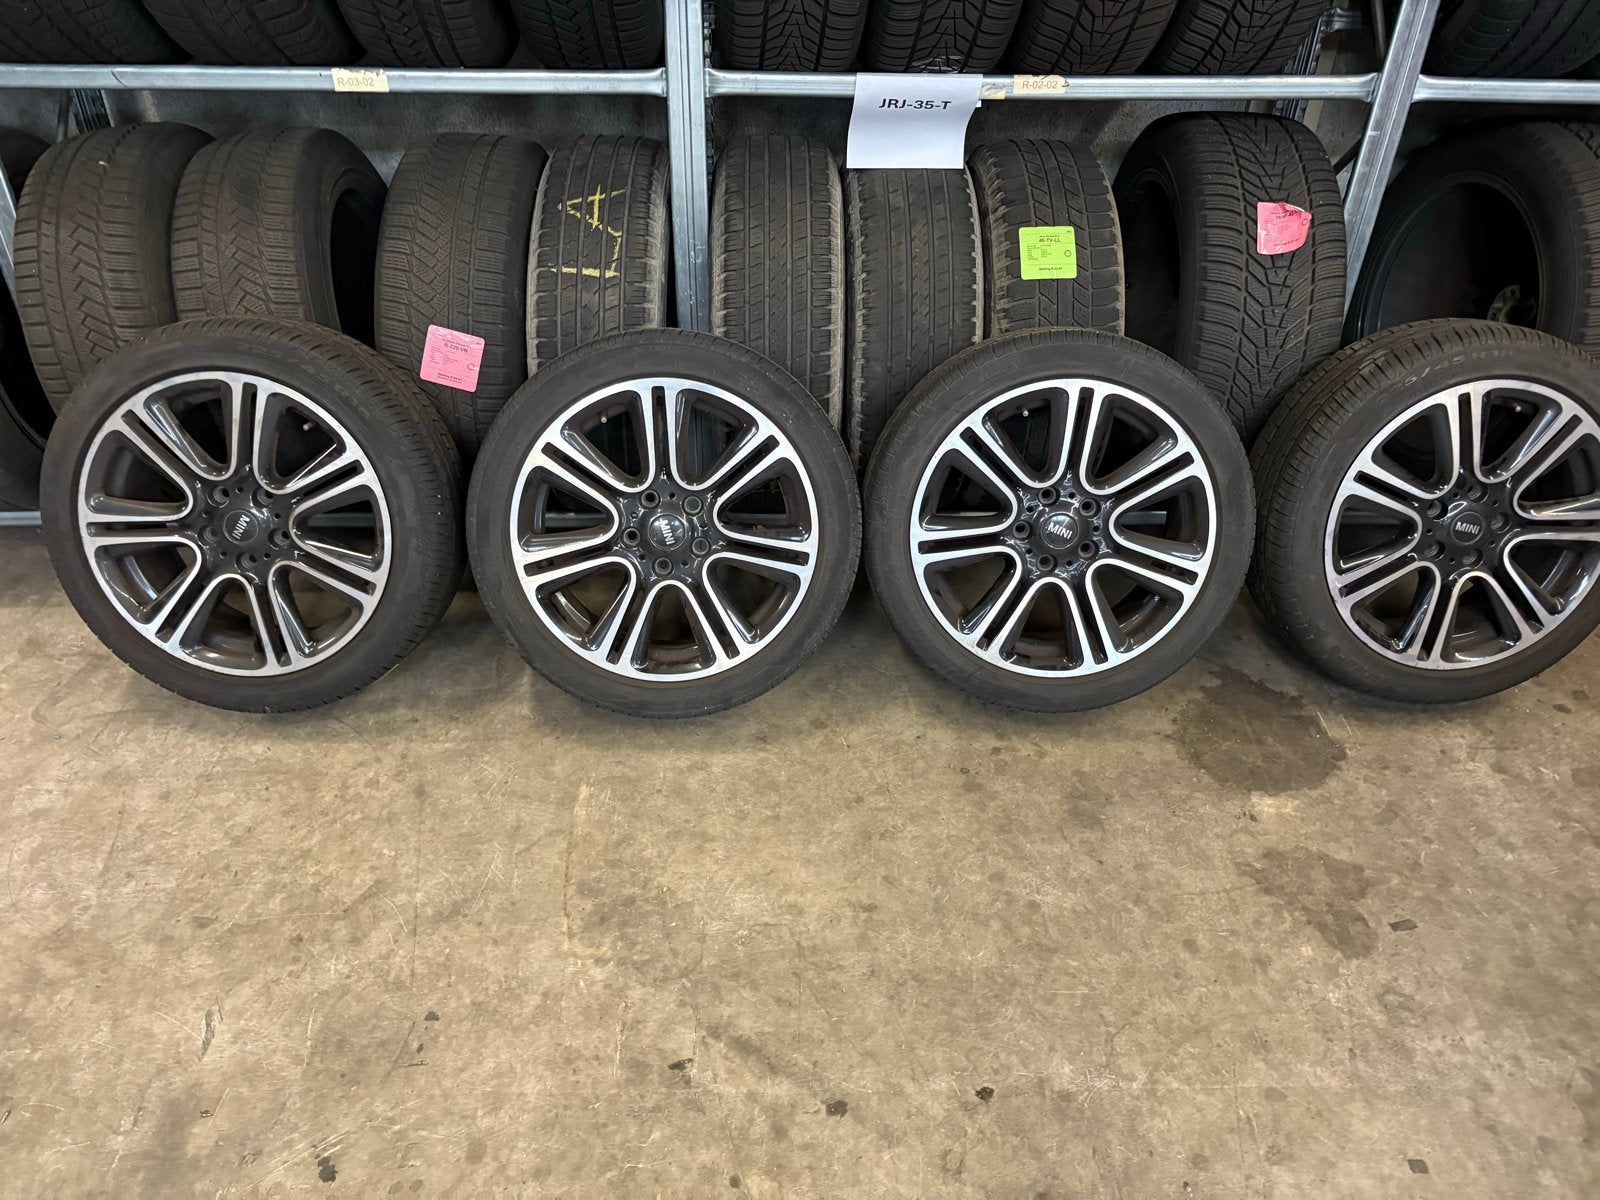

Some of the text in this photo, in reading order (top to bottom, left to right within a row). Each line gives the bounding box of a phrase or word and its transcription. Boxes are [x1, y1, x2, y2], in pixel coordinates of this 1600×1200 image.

[336, 77, 375, 87] R-03-02
[1022, 80, 1058, 89] R-02-02
[878, 98, 952, 110] JRJ-35-T
[231, 514, 251, 540] MINI
[659, 518, 676, 545] MINI
[1047, 522, 1073, 540] MINI
[1455, 521, 1480, 535] MINI
